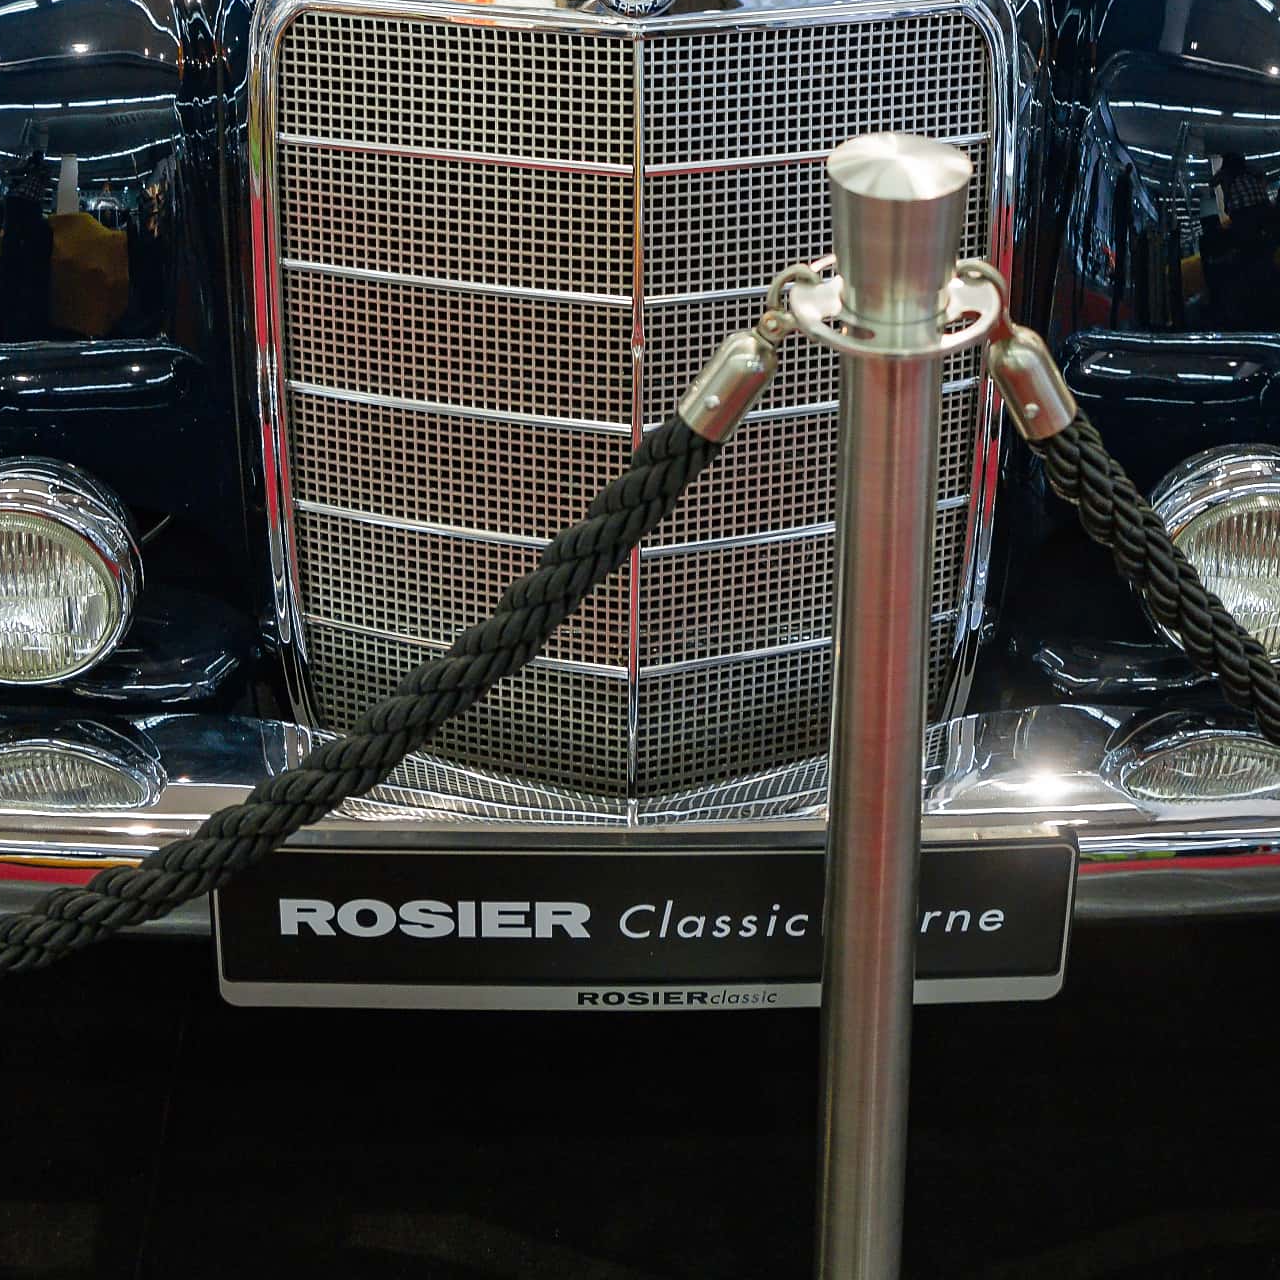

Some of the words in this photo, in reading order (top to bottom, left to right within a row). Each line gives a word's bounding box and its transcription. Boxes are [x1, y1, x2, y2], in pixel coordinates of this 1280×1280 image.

[617, 1, 653, 16] BENZ
[279, 898, 591, 939] ROSIER
[619, 899, 810, 940] Classic
